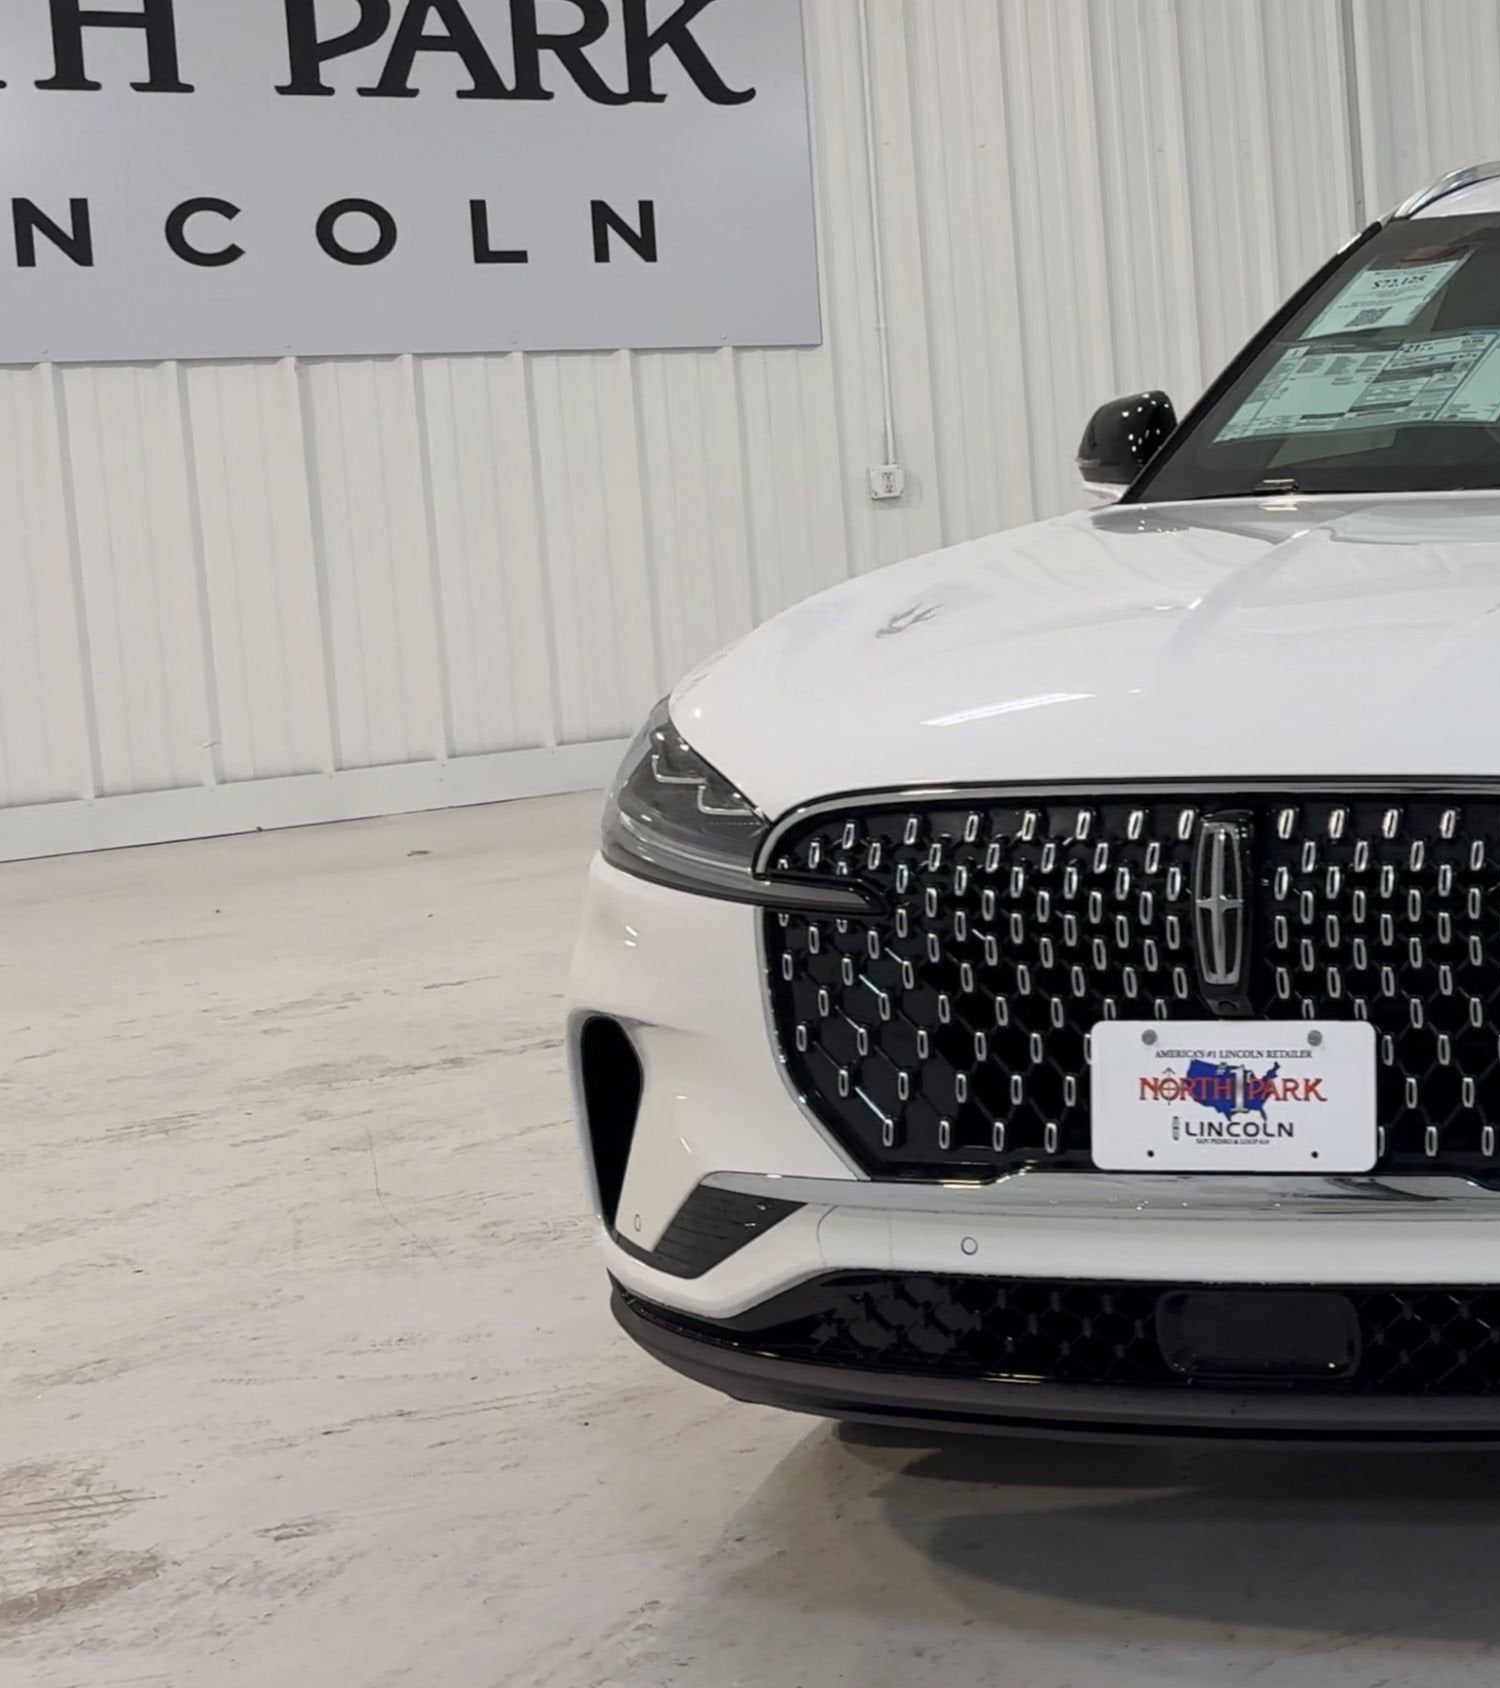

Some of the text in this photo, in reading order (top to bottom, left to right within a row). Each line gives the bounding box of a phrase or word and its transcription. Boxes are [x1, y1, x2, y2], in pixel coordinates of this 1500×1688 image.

[0, 0, 756, 106] H PARK
[1219, 1050, 1264, 1058] LINCOLN
[1266, 1050, 1312, 1059] RETAILER
[1139, 1076, 1328, 1102] NORTH PARK
[1185, 1121, 1294, 1137] LINCOLN
